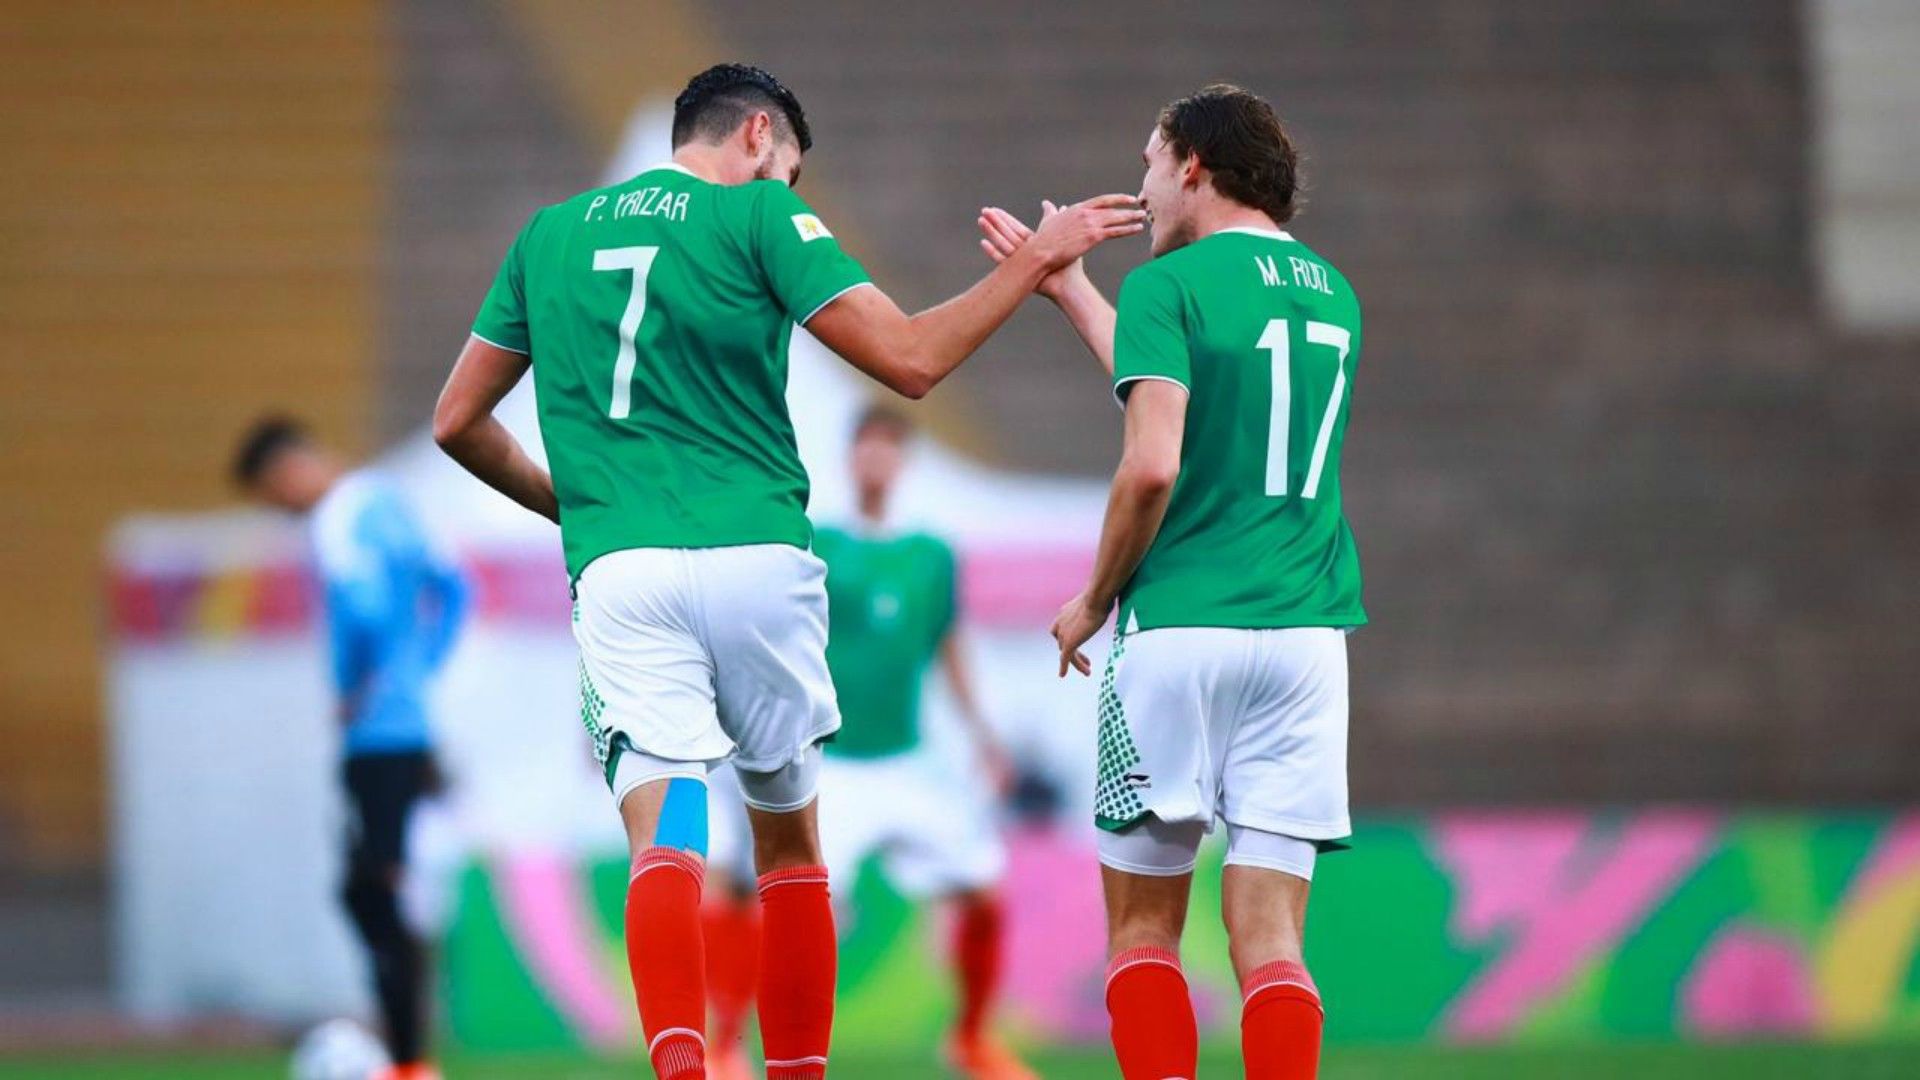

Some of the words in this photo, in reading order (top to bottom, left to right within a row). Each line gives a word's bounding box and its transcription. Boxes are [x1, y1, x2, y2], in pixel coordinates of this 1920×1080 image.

[584, 195, 608, 222] P.
[614, 186, 691, 222] YRIZAR
[1254, 254, 1288, 286] M.
[1287, 255, 1334, 296] RUIZ
[592, 245, 660, 419] 7
[1254, 318, 1352, 500] 17
